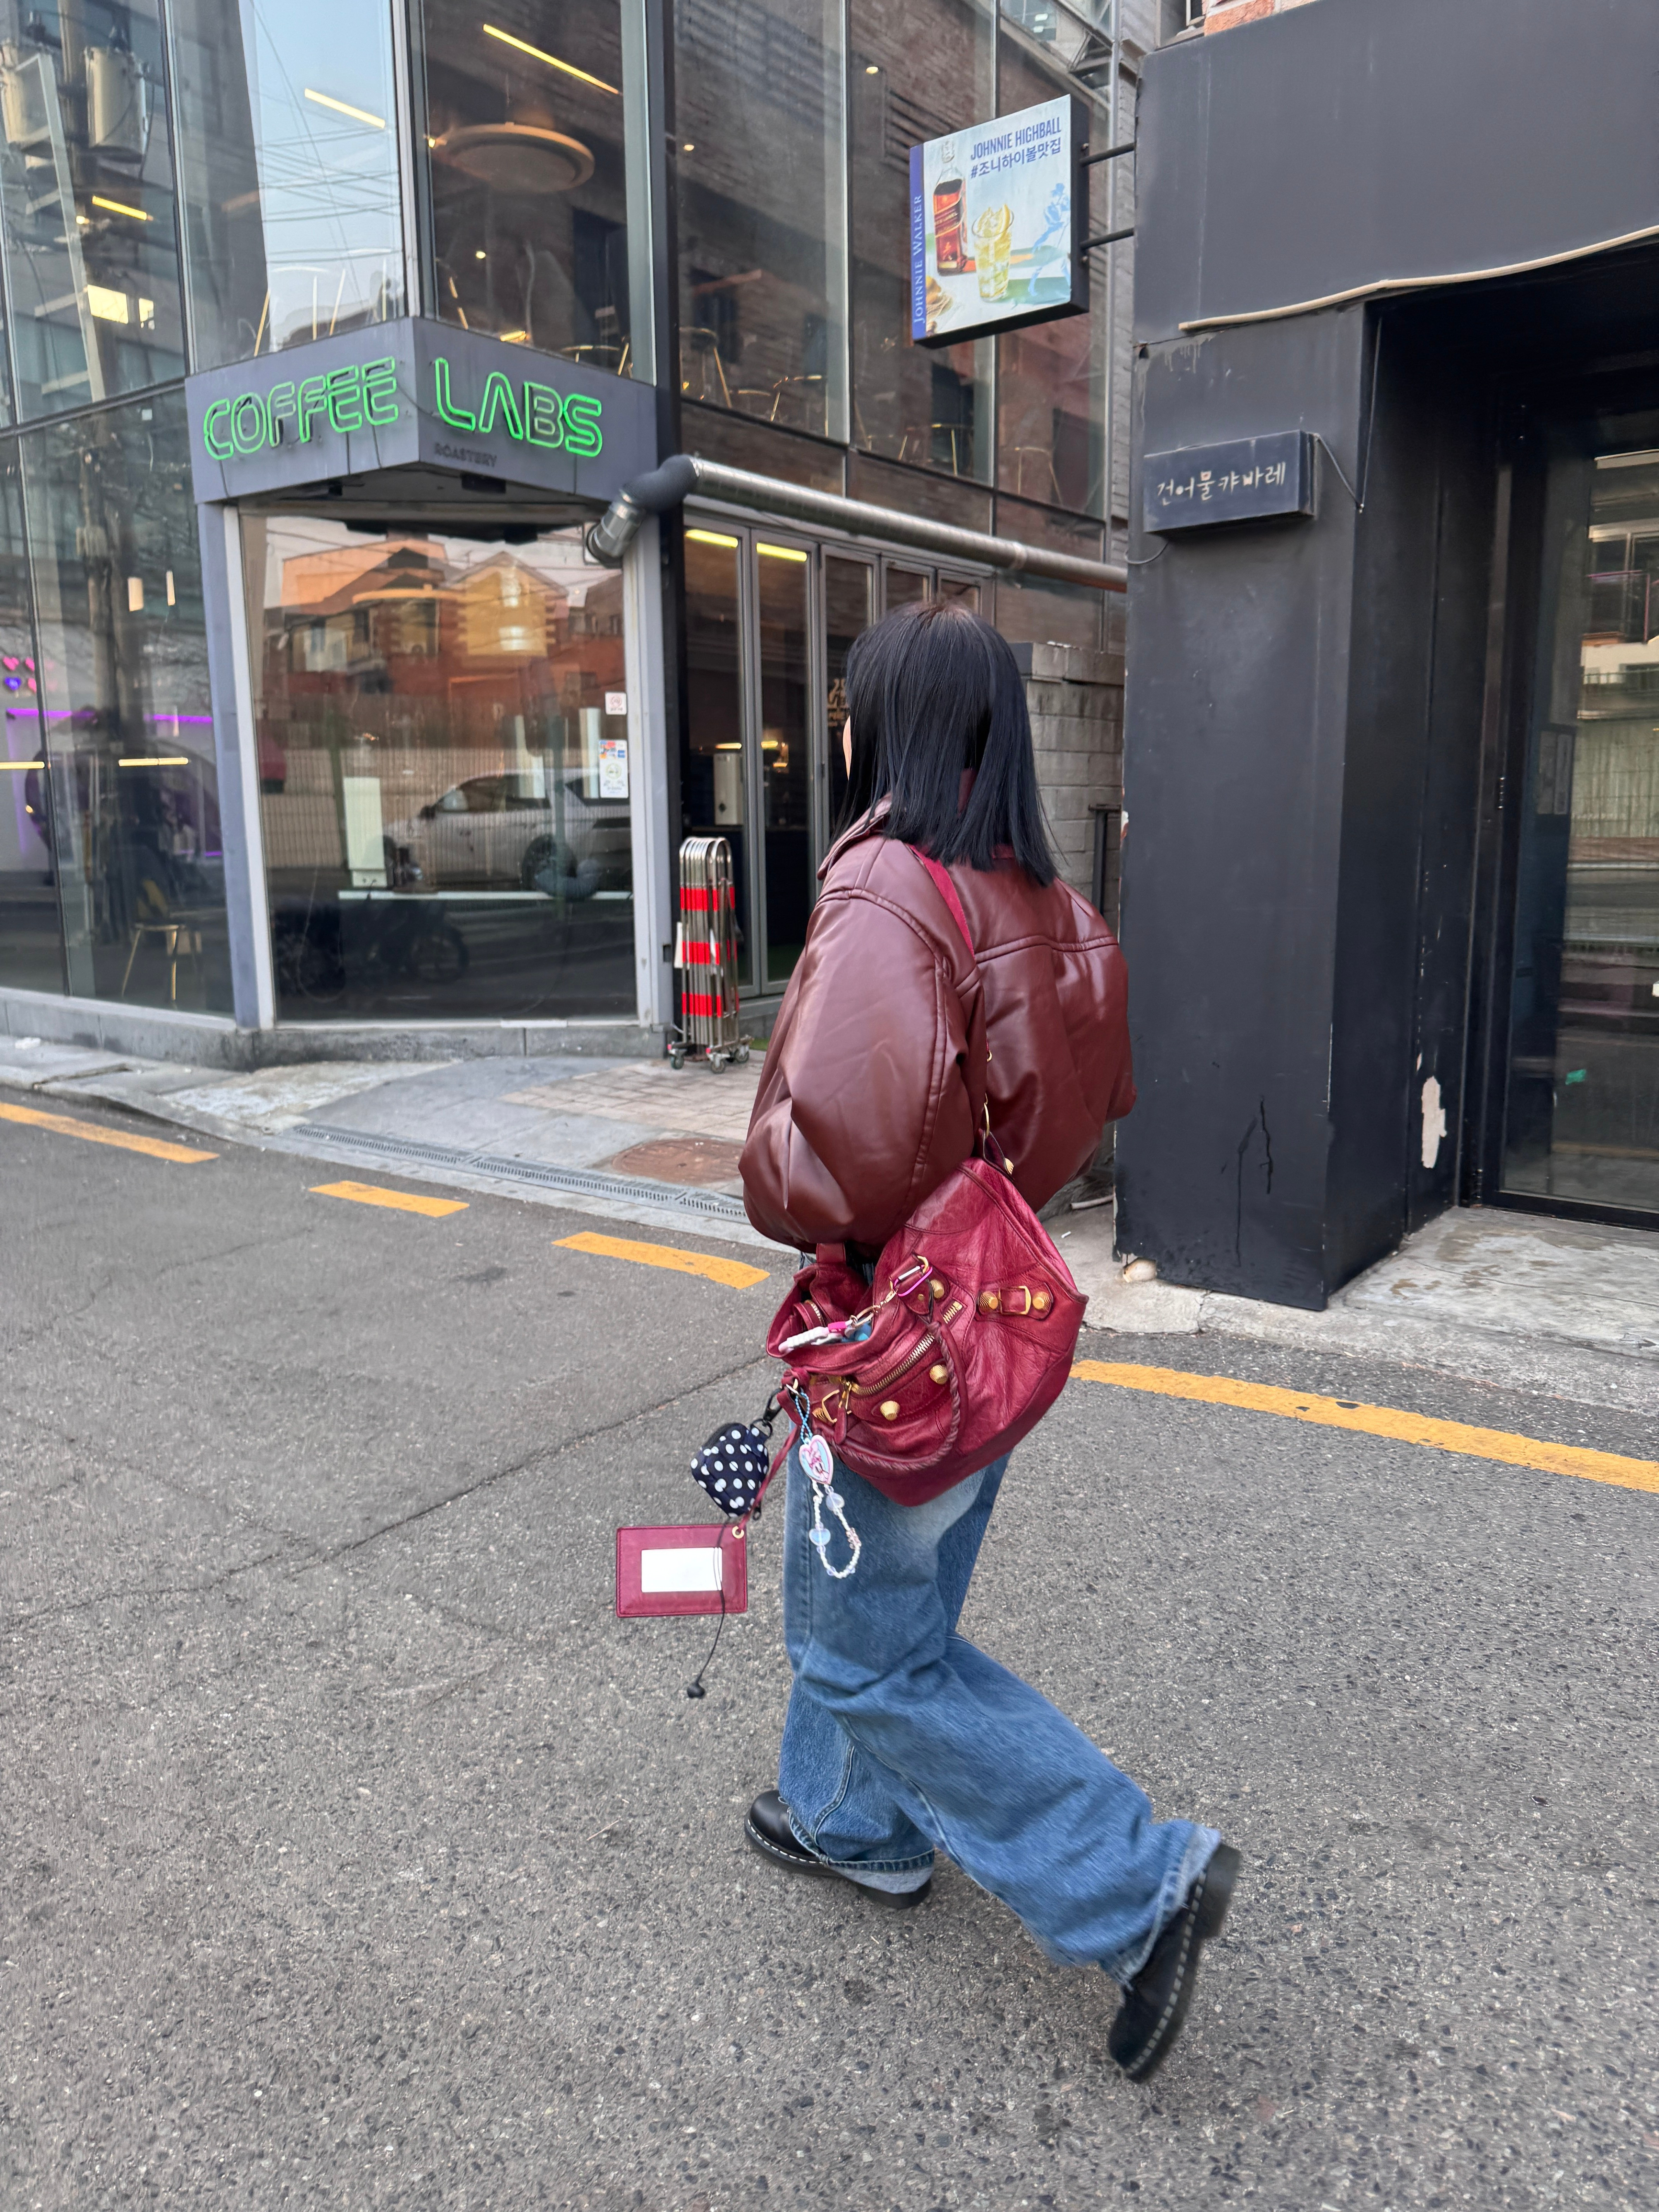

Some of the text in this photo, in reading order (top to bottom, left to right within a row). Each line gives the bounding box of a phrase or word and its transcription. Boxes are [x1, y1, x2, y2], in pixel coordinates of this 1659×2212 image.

[970, 117, 1061, 160] JOHNNIE HIGHBALL
[970, 137, 1061, 179] #조니하이볼맛집
[913, 195, 925, 323] JOHNNIE WALKER
[203, 356, 603, 460] COFFEE LABS
